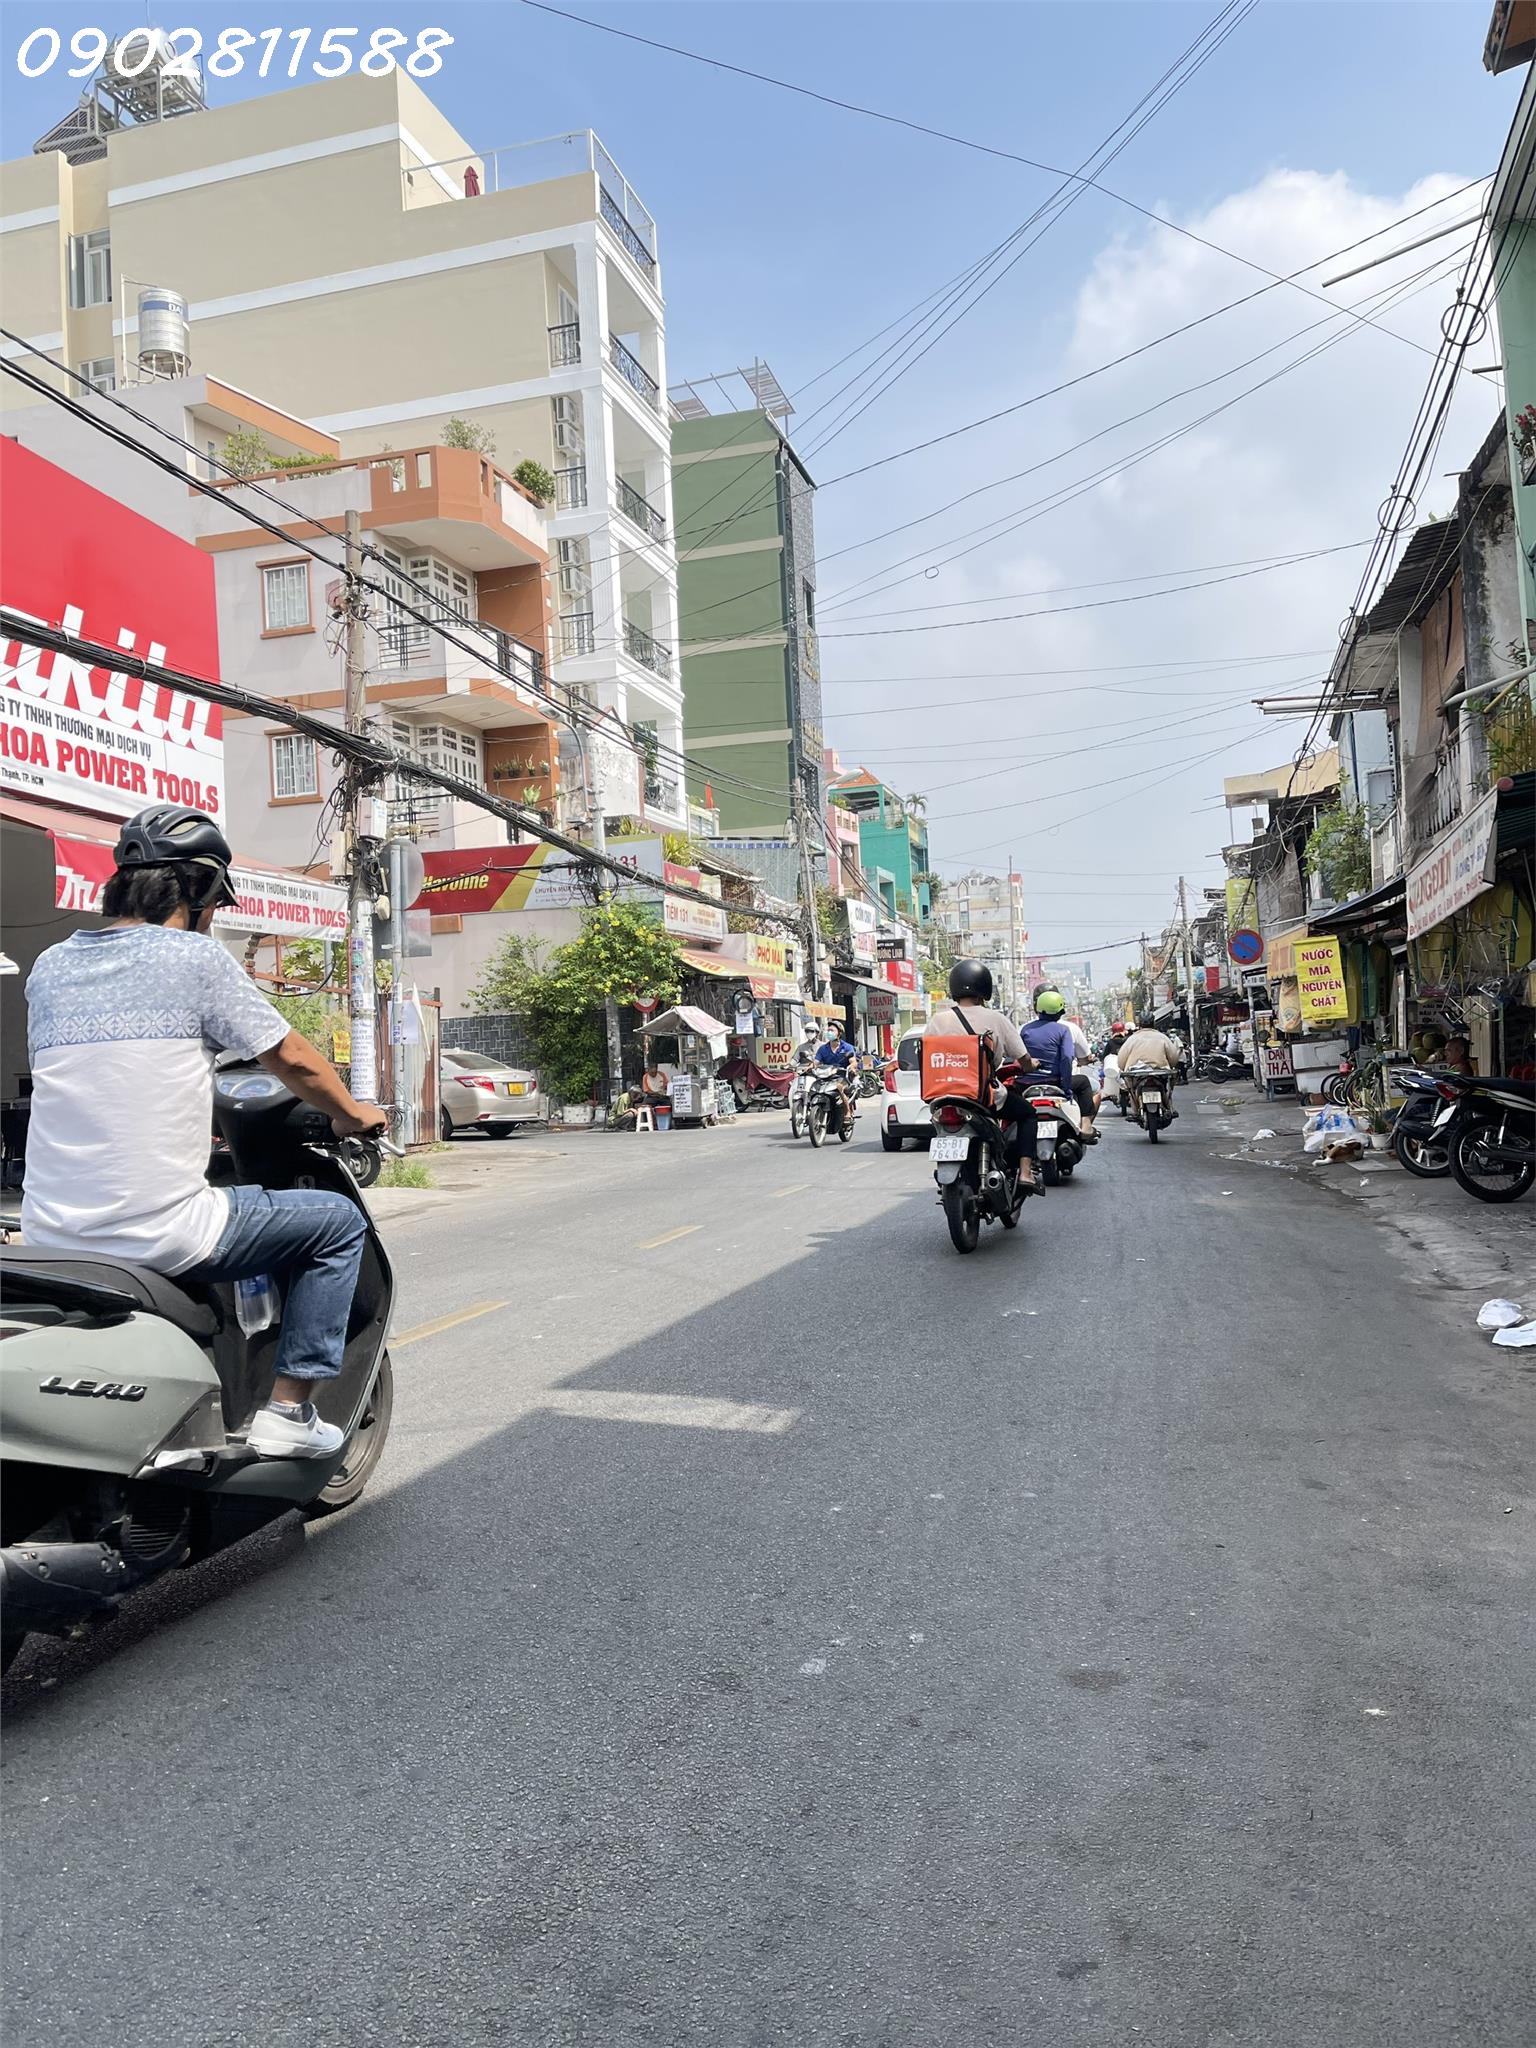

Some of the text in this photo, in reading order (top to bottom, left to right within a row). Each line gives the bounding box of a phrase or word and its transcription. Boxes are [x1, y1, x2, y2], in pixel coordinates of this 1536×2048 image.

[7, 699, 22, 717] TY
[24, 703, 52, 728] TNHH
[54, 711, 94, 741] THƯƠNG
[96, 727, 115, 749] MẠI
[117, 733, 138, 755] DỊCH
[140, 743, 152, 760] VỤ
[56, 738, 148, 795] POWER
[152, 767, 219, 814] TOOLS
[267, 899, 311, 924] POWER
[313, 907, 346, 929] TOOLS
[1301, 947, 1334, 961] NƯỚC
[1308, 965, 1332, 976] MÍA
[1302, 979, 1342, 993] NGUYÊN
[869, 995, 893, 1006] THANH
[1311, 994, 1337, 1008] CHẤT
[763, 1038, 791, 1053] PHỞ
[768, 1054, 788, 1064] MAI
[945, 1060, 969, 1068] Food
[39, 1375, 148, 1402] LEAD
